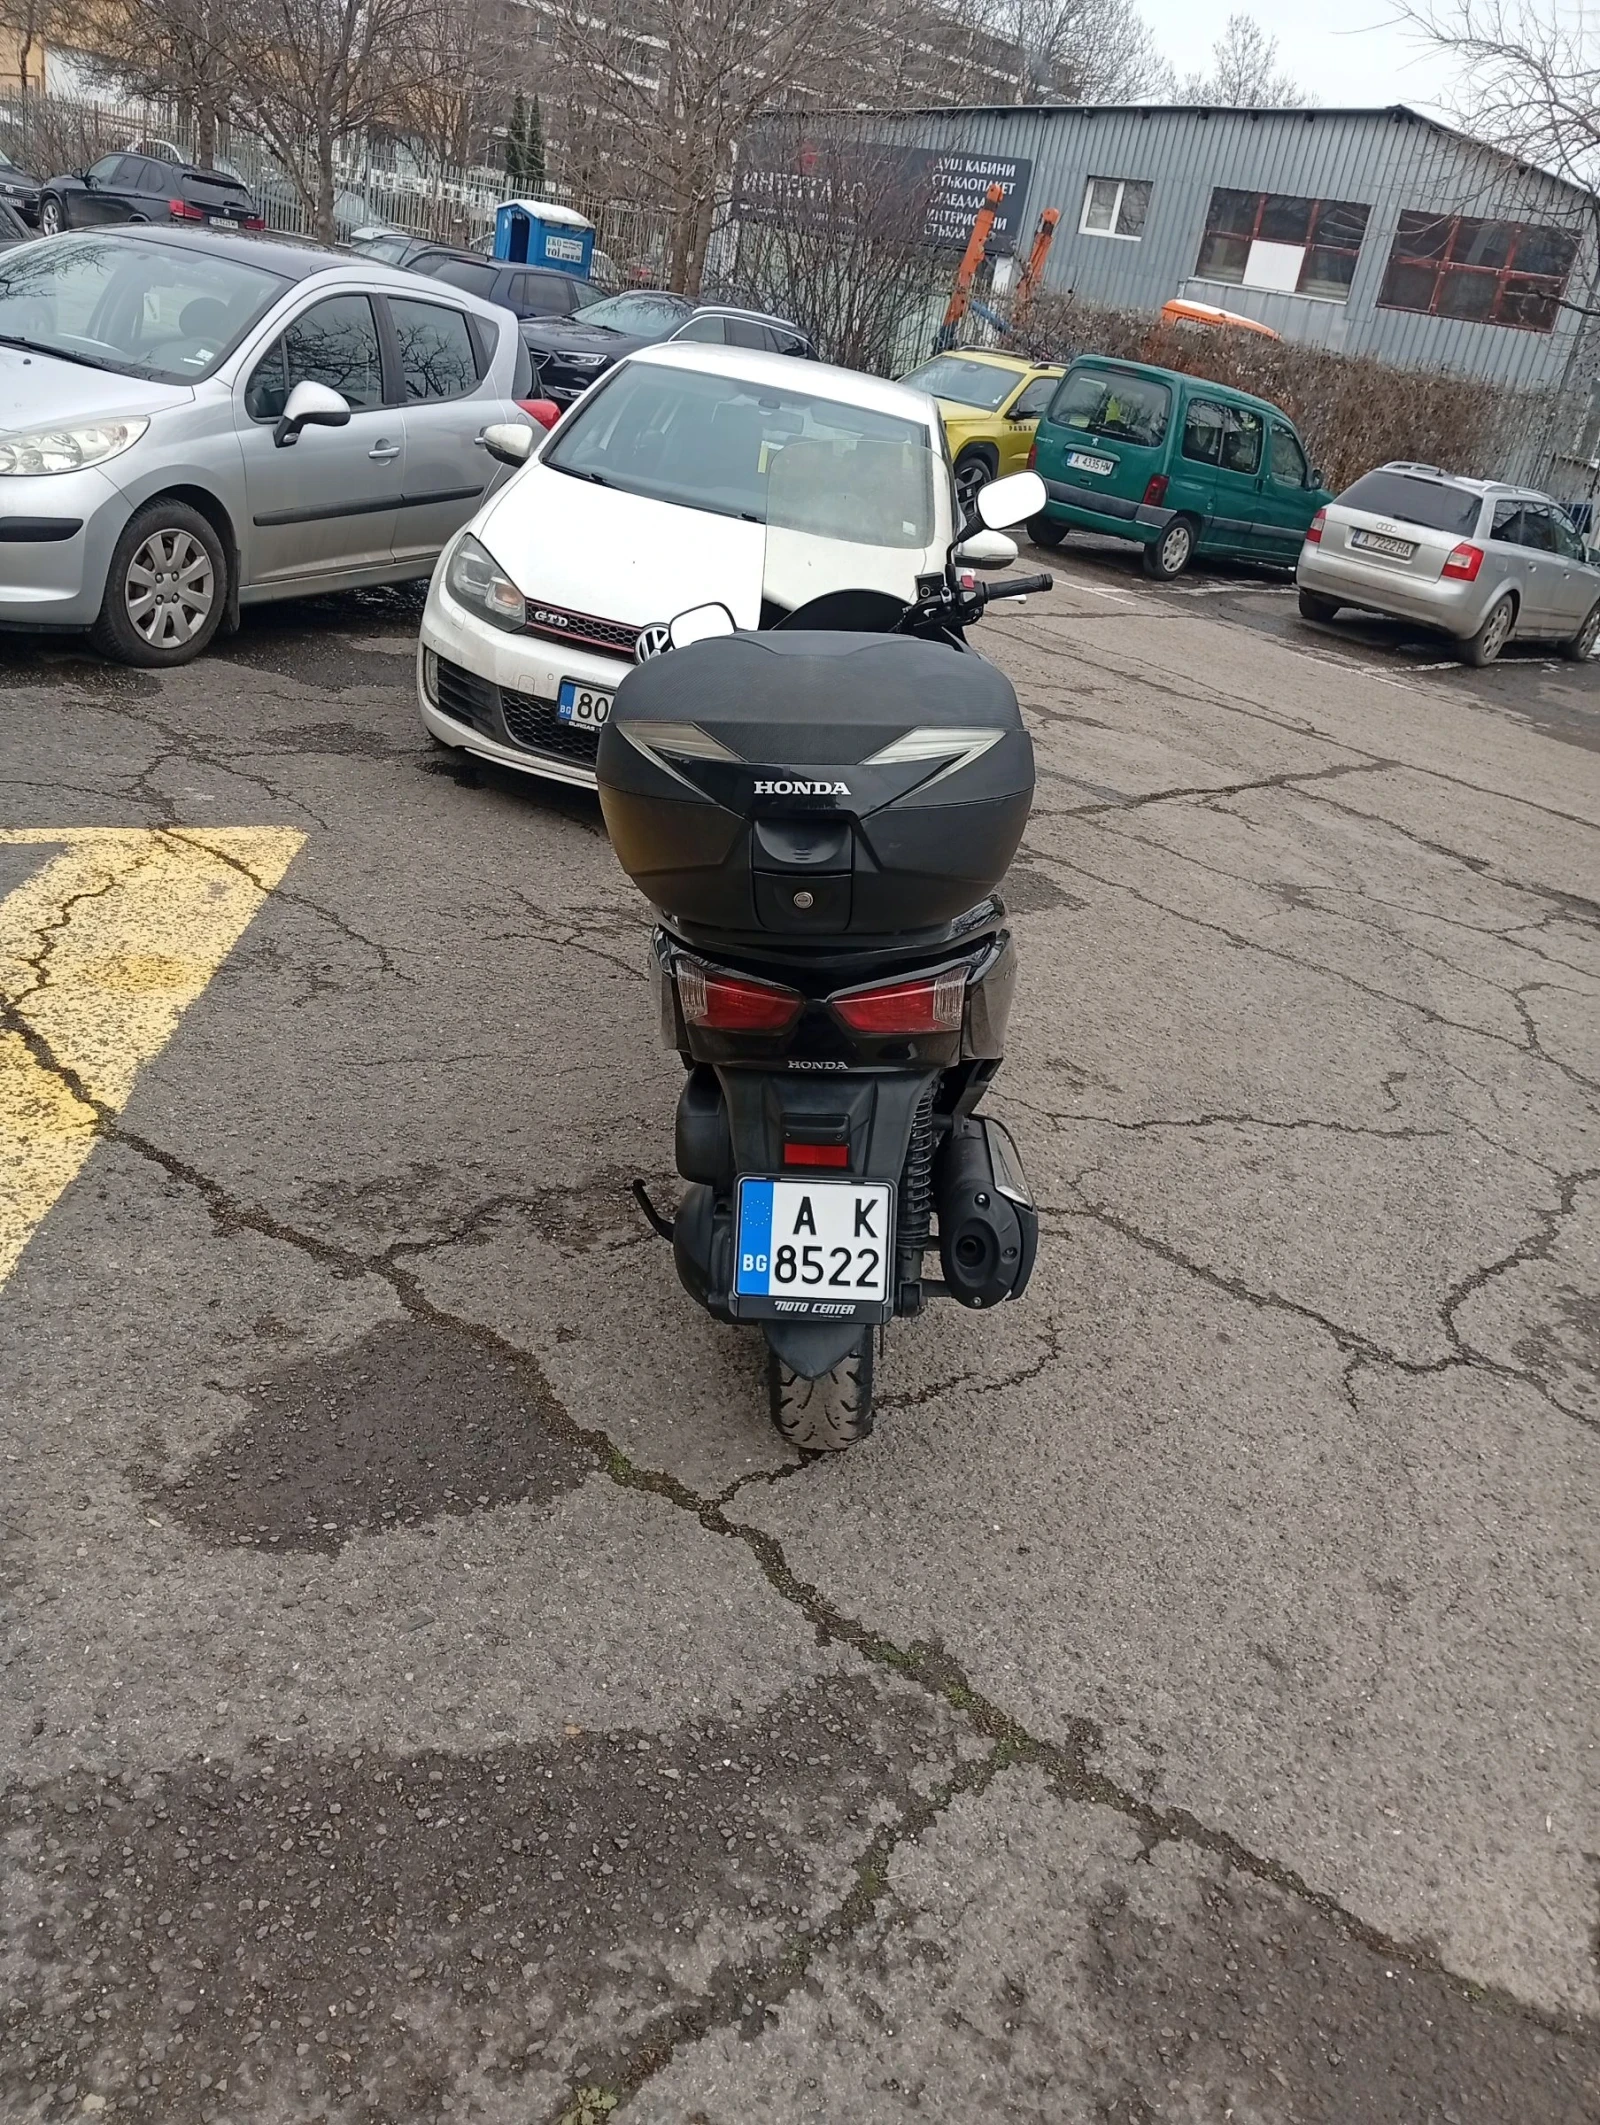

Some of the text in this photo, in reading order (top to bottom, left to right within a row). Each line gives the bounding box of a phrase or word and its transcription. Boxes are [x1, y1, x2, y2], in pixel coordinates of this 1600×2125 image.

[965, 159, 1016, 177] КАБИНИ
[926, 208, 1008, 231] ИНТЕРИОНИ
[1073, 455, 1080, 464] A
[1362, 534, 1411, 556] A 7222 HA
[534, 610, 568, 627] GTD
[559, 704, 572, 715] BG
[753, 780, 852, 796] HONDA
[787, 1060, 849, 1070] HONDA
[792, 1196, 879, 1239] A K
[742, 1244, 880, 1288] BG 8522
[774, 1300, 856, 1315] MOTO CENTER
